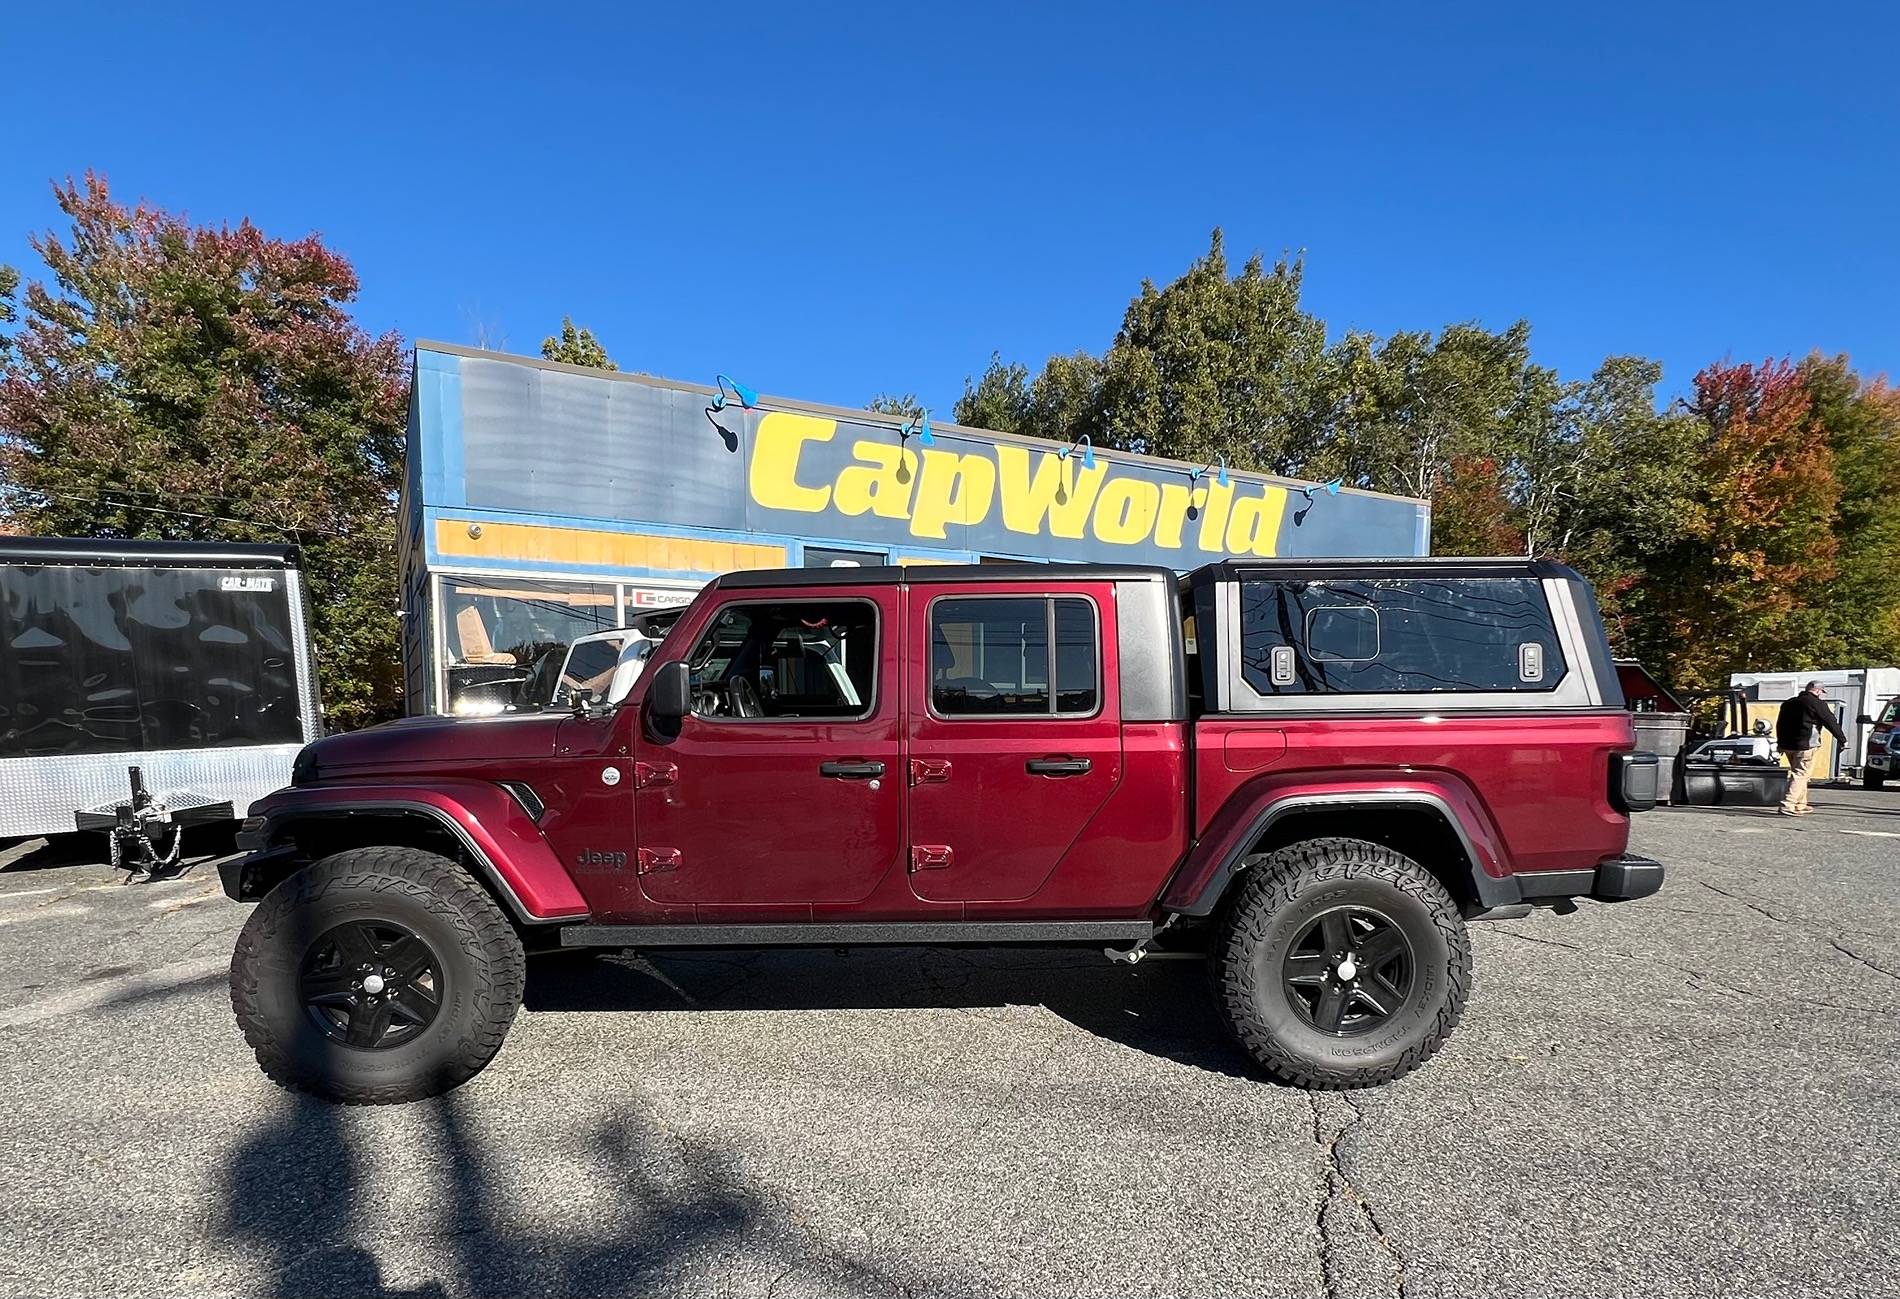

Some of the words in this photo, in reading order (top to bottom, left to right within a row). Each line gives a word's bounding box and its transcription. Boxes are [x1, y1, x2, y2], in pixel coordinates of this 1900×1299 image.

[749, 411, 1288, 559] CapWorld
[657, 595, 692, 604] CARGO
[576, 847, 628, 870] Jeep
